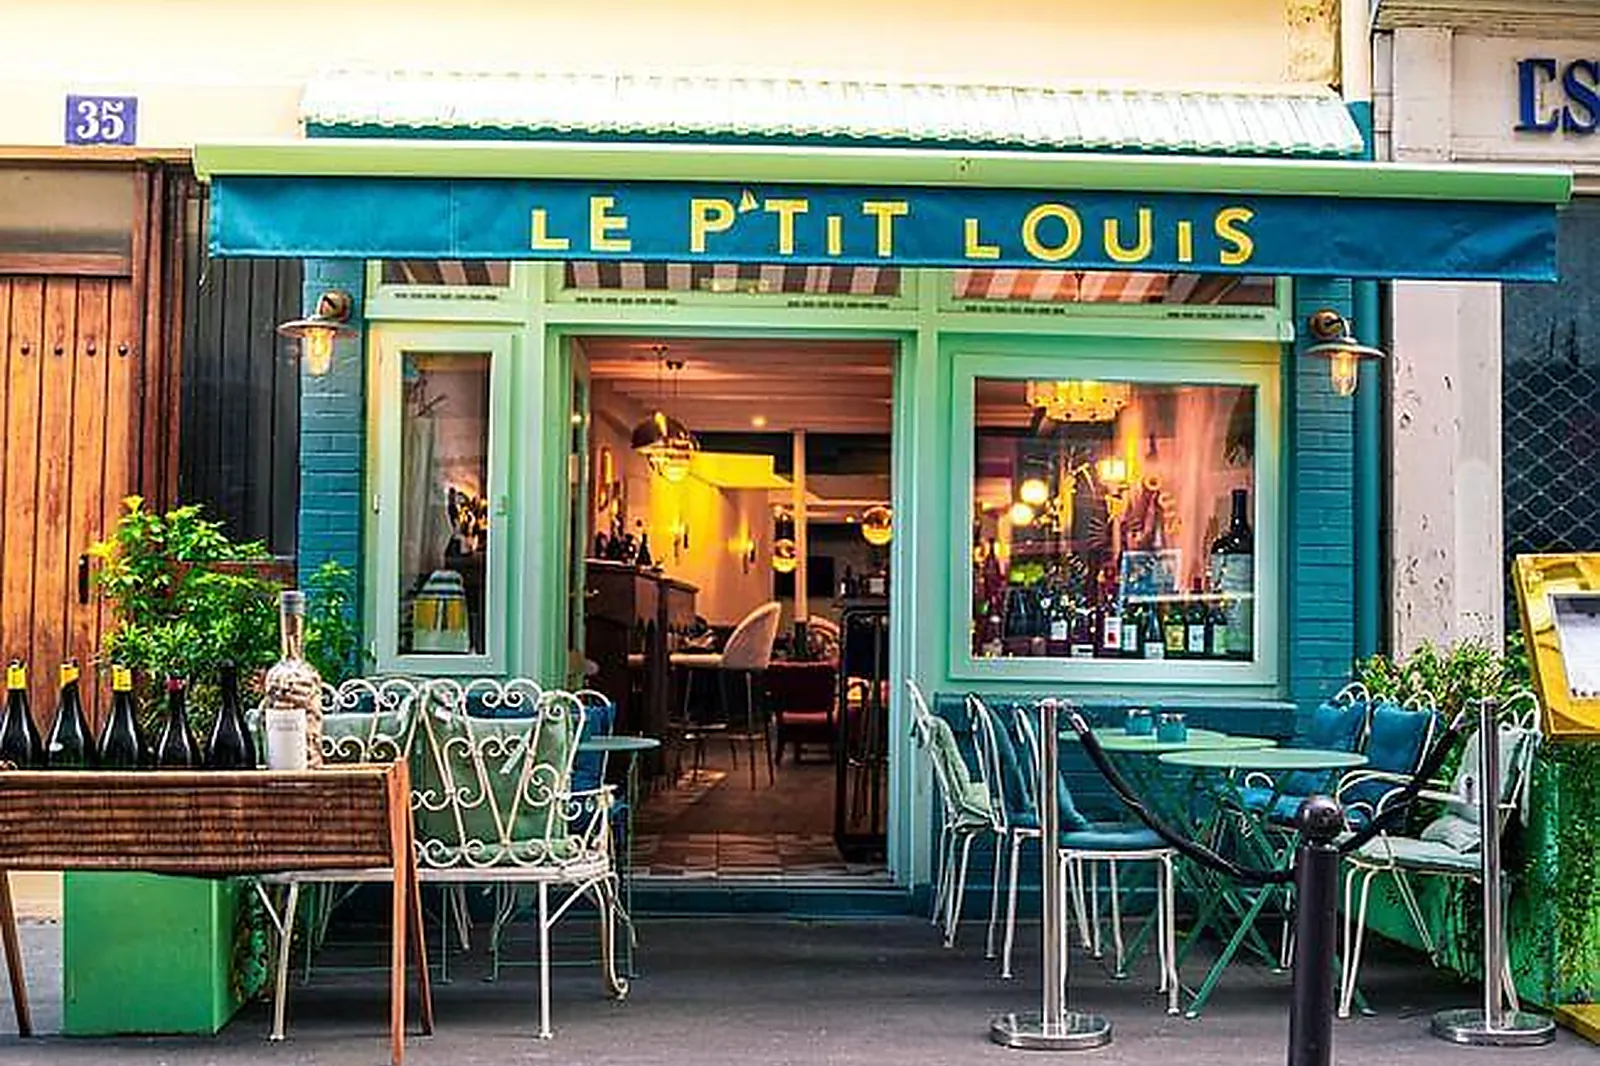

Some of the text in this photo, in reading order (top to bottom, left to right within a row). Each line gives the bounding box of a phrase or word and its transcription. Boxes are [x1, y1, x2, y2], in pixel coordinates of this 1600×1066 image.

[76, 100, 124, 140] 35
[531, 189, 1254, 265] LE P'TIT LOUIS
